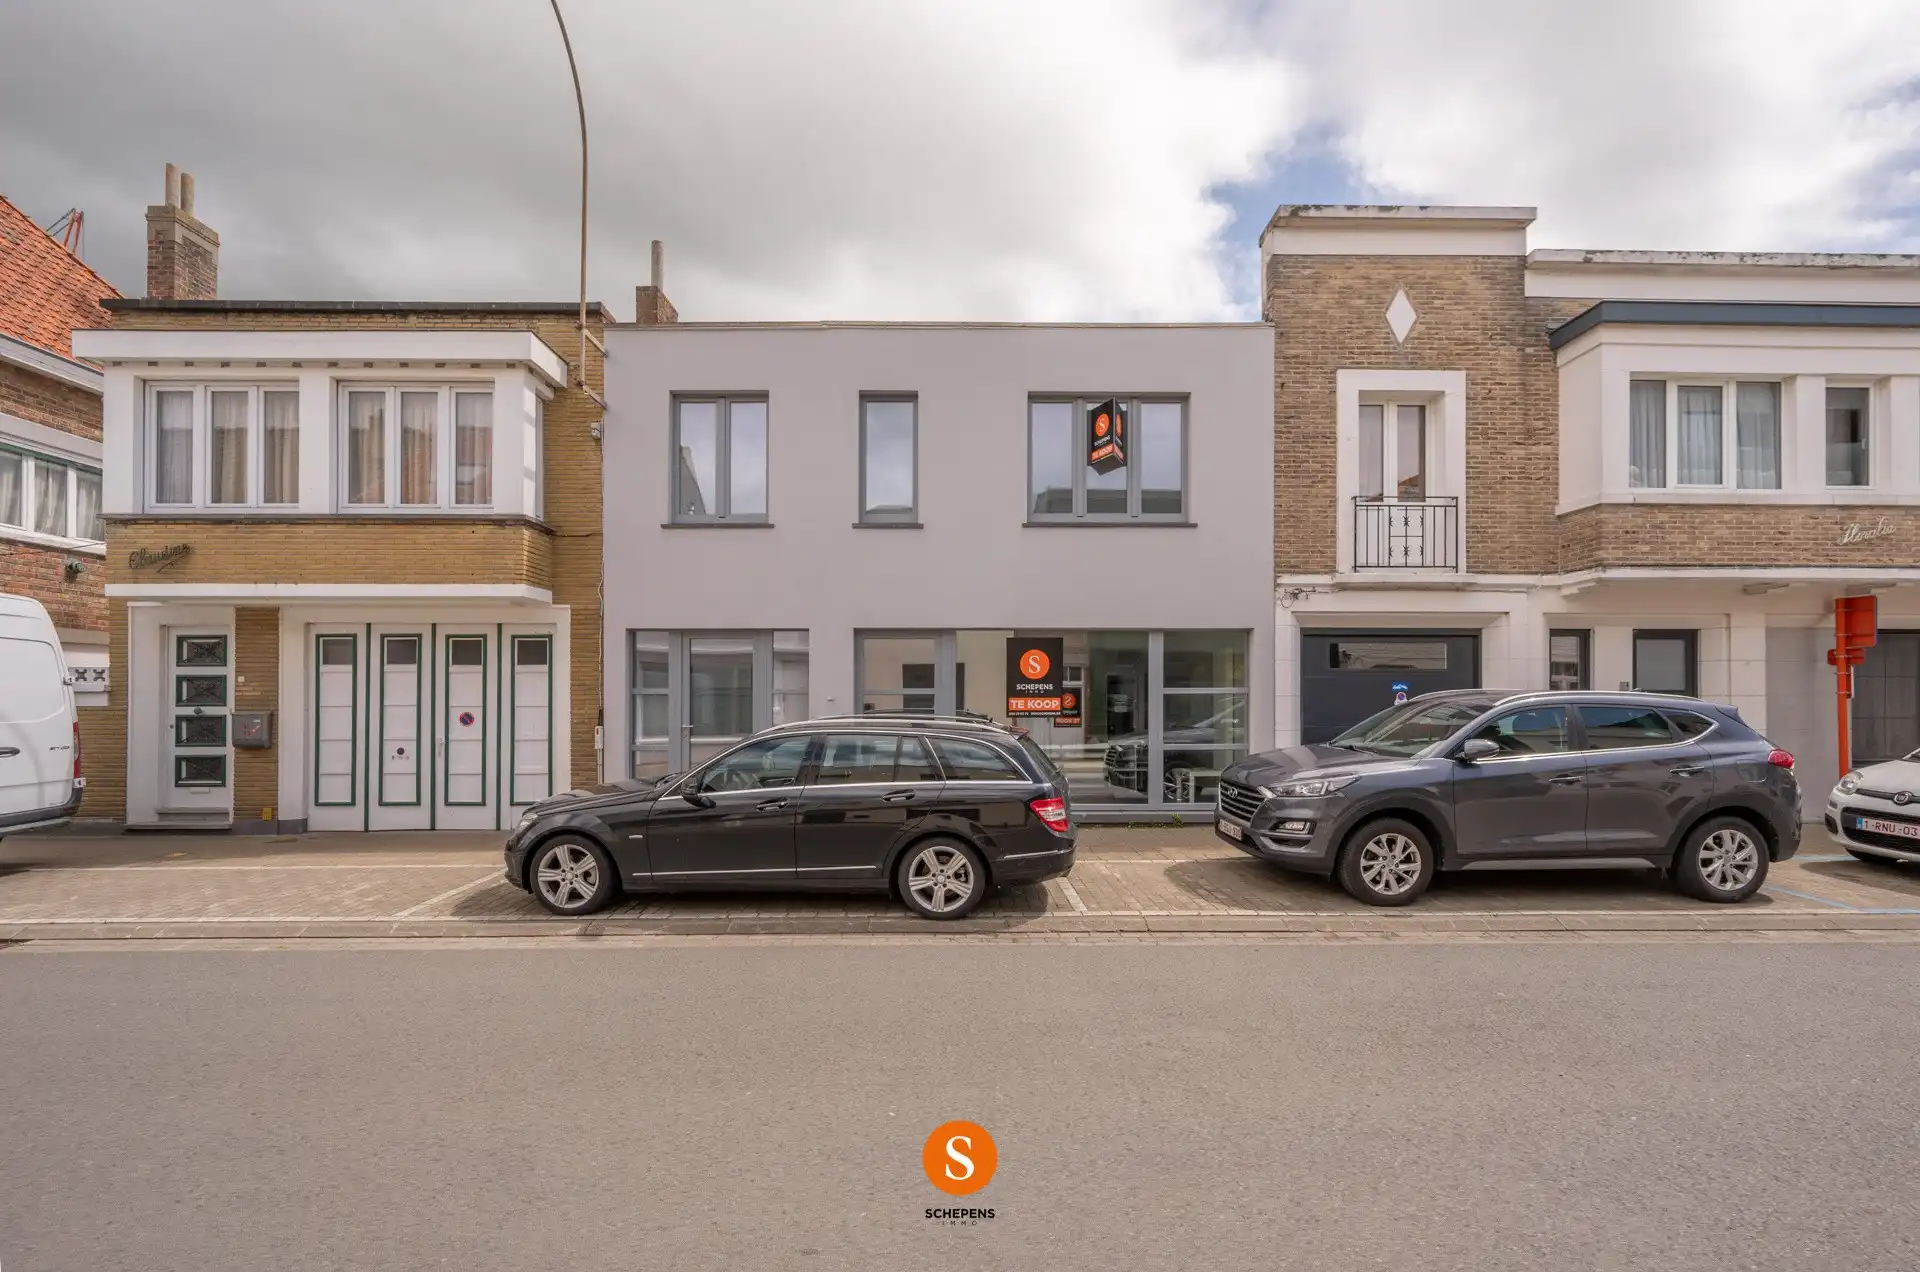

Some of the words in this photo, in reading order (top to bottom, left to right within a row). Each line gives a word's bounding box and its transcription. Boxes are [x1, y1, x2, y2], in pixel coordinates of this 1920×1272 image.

[1028, 655, 1041, 674] S
[1010, 699, 1025, 709] TE
[1027, 699, 1060, 709] KOOP
